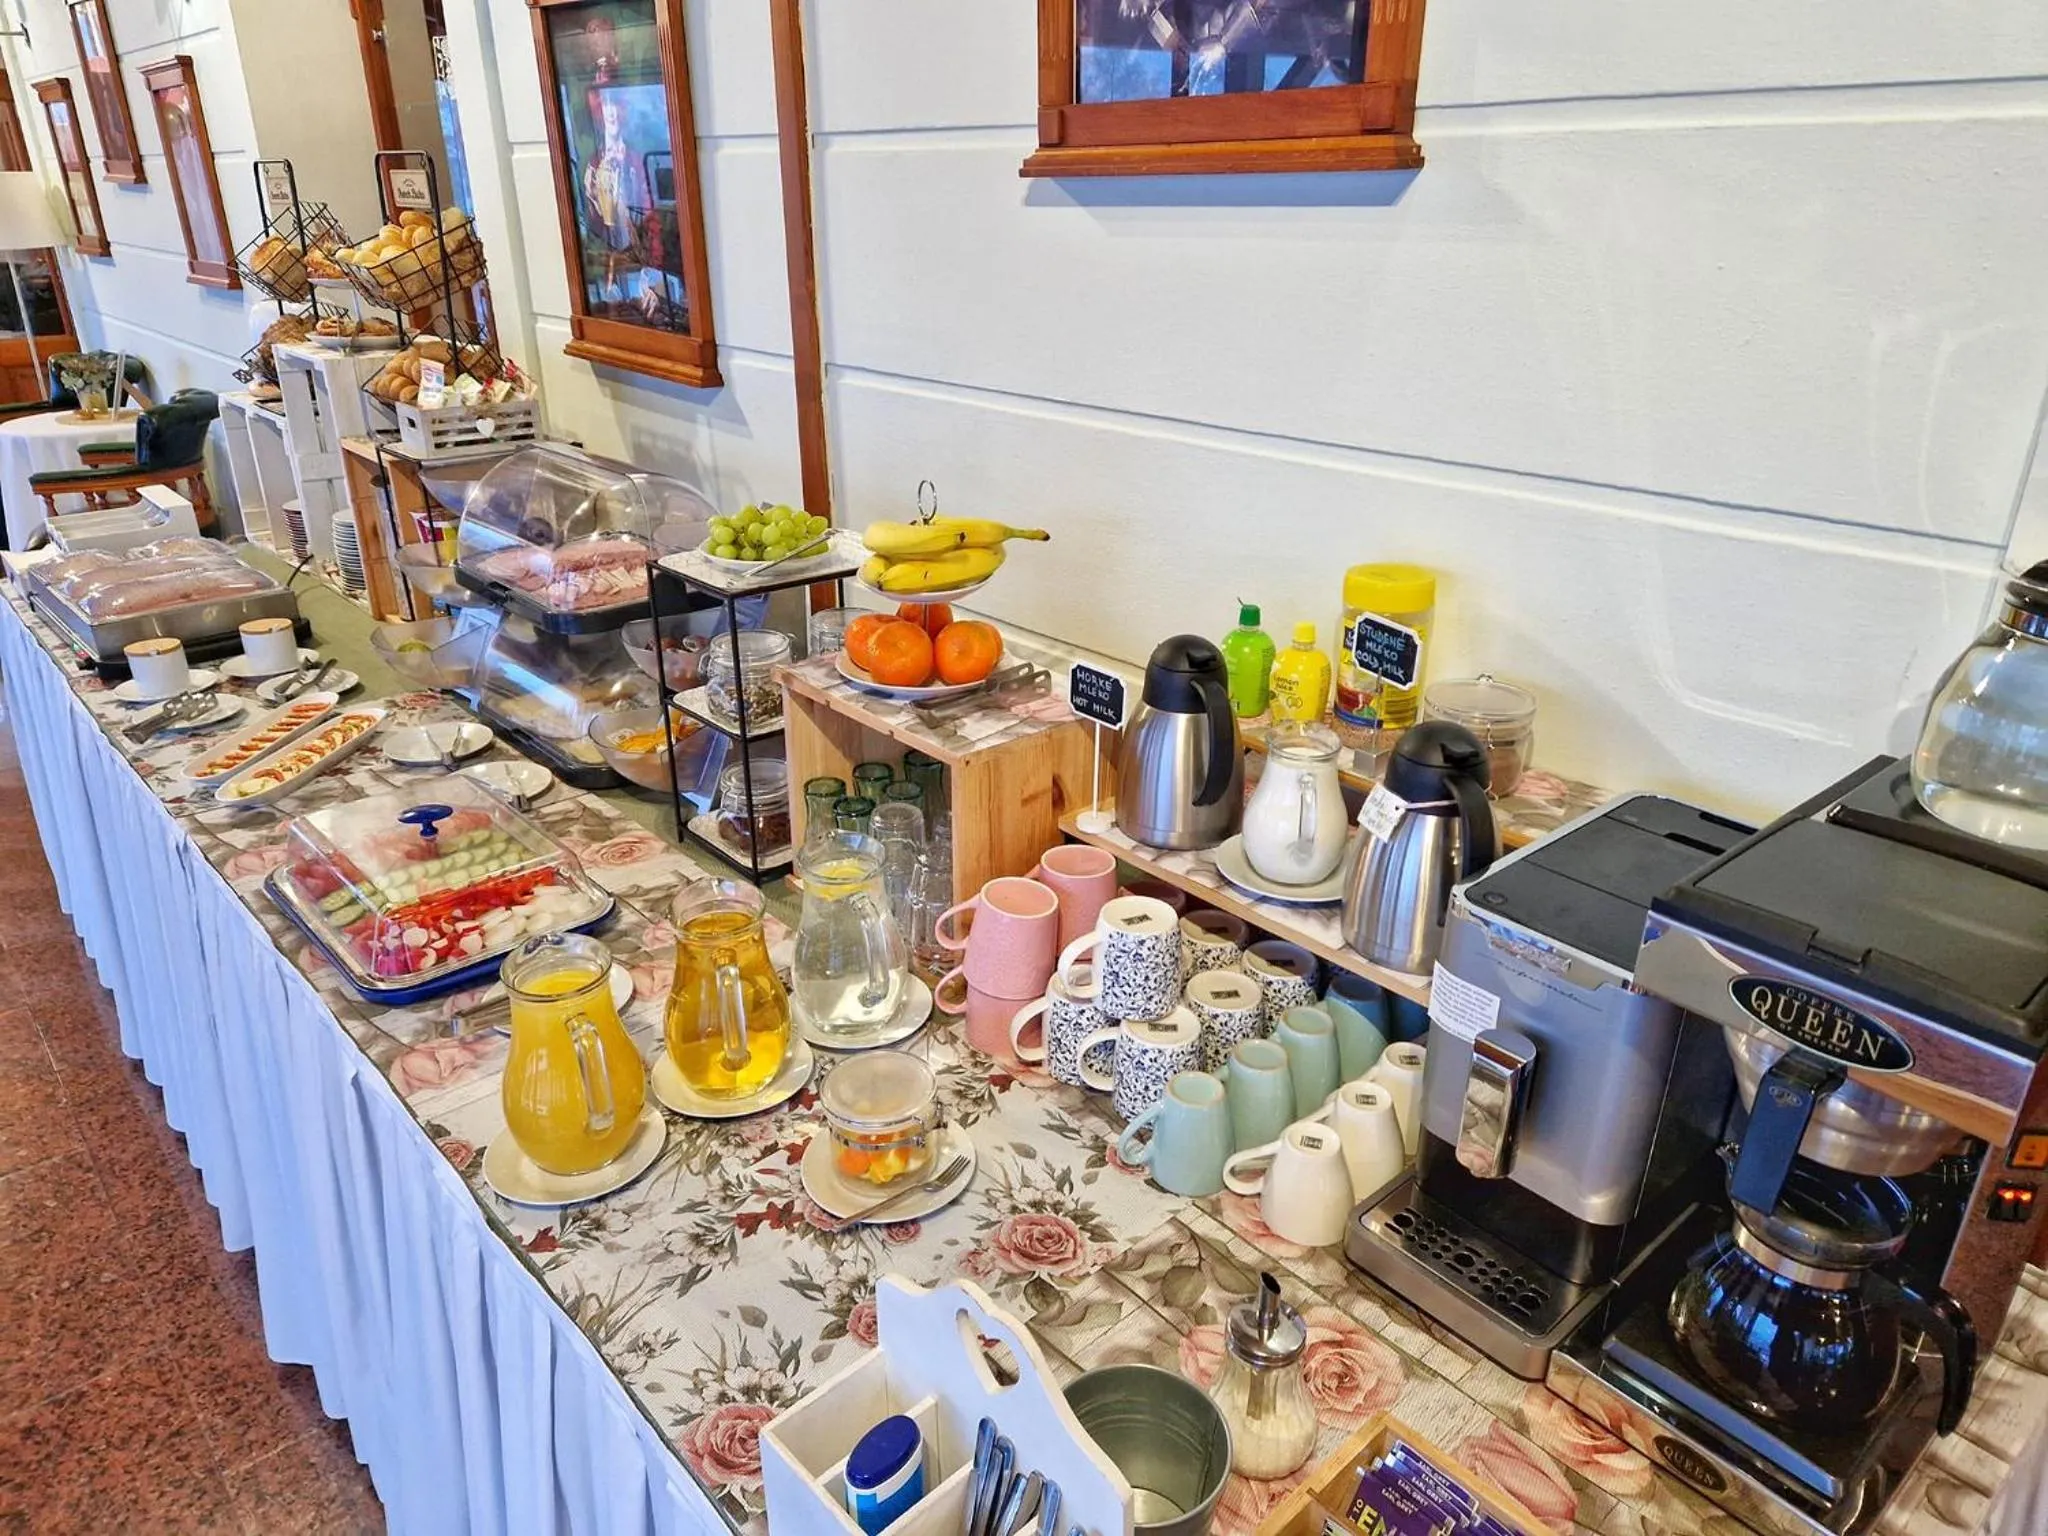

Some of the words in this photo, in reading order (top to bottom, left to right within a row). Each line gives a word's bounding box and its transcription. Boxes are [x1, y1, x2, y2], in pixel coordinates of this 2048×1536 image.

[1356, 649, 1379, 668] COLD
[1382, 661, 1405, 682] MILK
[1073, 694, 1088, 708] HOT
[1093, 703, 1116, 720] MILK
[1786, 986, 1855, 1022] COFFEE
[1750, 985, 1885, 1061] QUEEN
[1419, 1460, 1433, 1475] EARL
[1433, 1472, 1450, 1487] GREY
[1663, 1445, 1715, 1486] QUEEN
[1397, 1479, 1412, 1494] EARL
[1411, 1491, 1429, 1507] GREY
[1411, 1476, 1426, 1491] EARL
[1426, 1488, 1442, 1504] GREY
[1421, 1473, 1436, 1489] EARL
[1435, 1485, 1452, 1501] GREY
[1381, 1488, 1396, 1503] EARL
[1396, 1500, 1413, 1516] GREY
